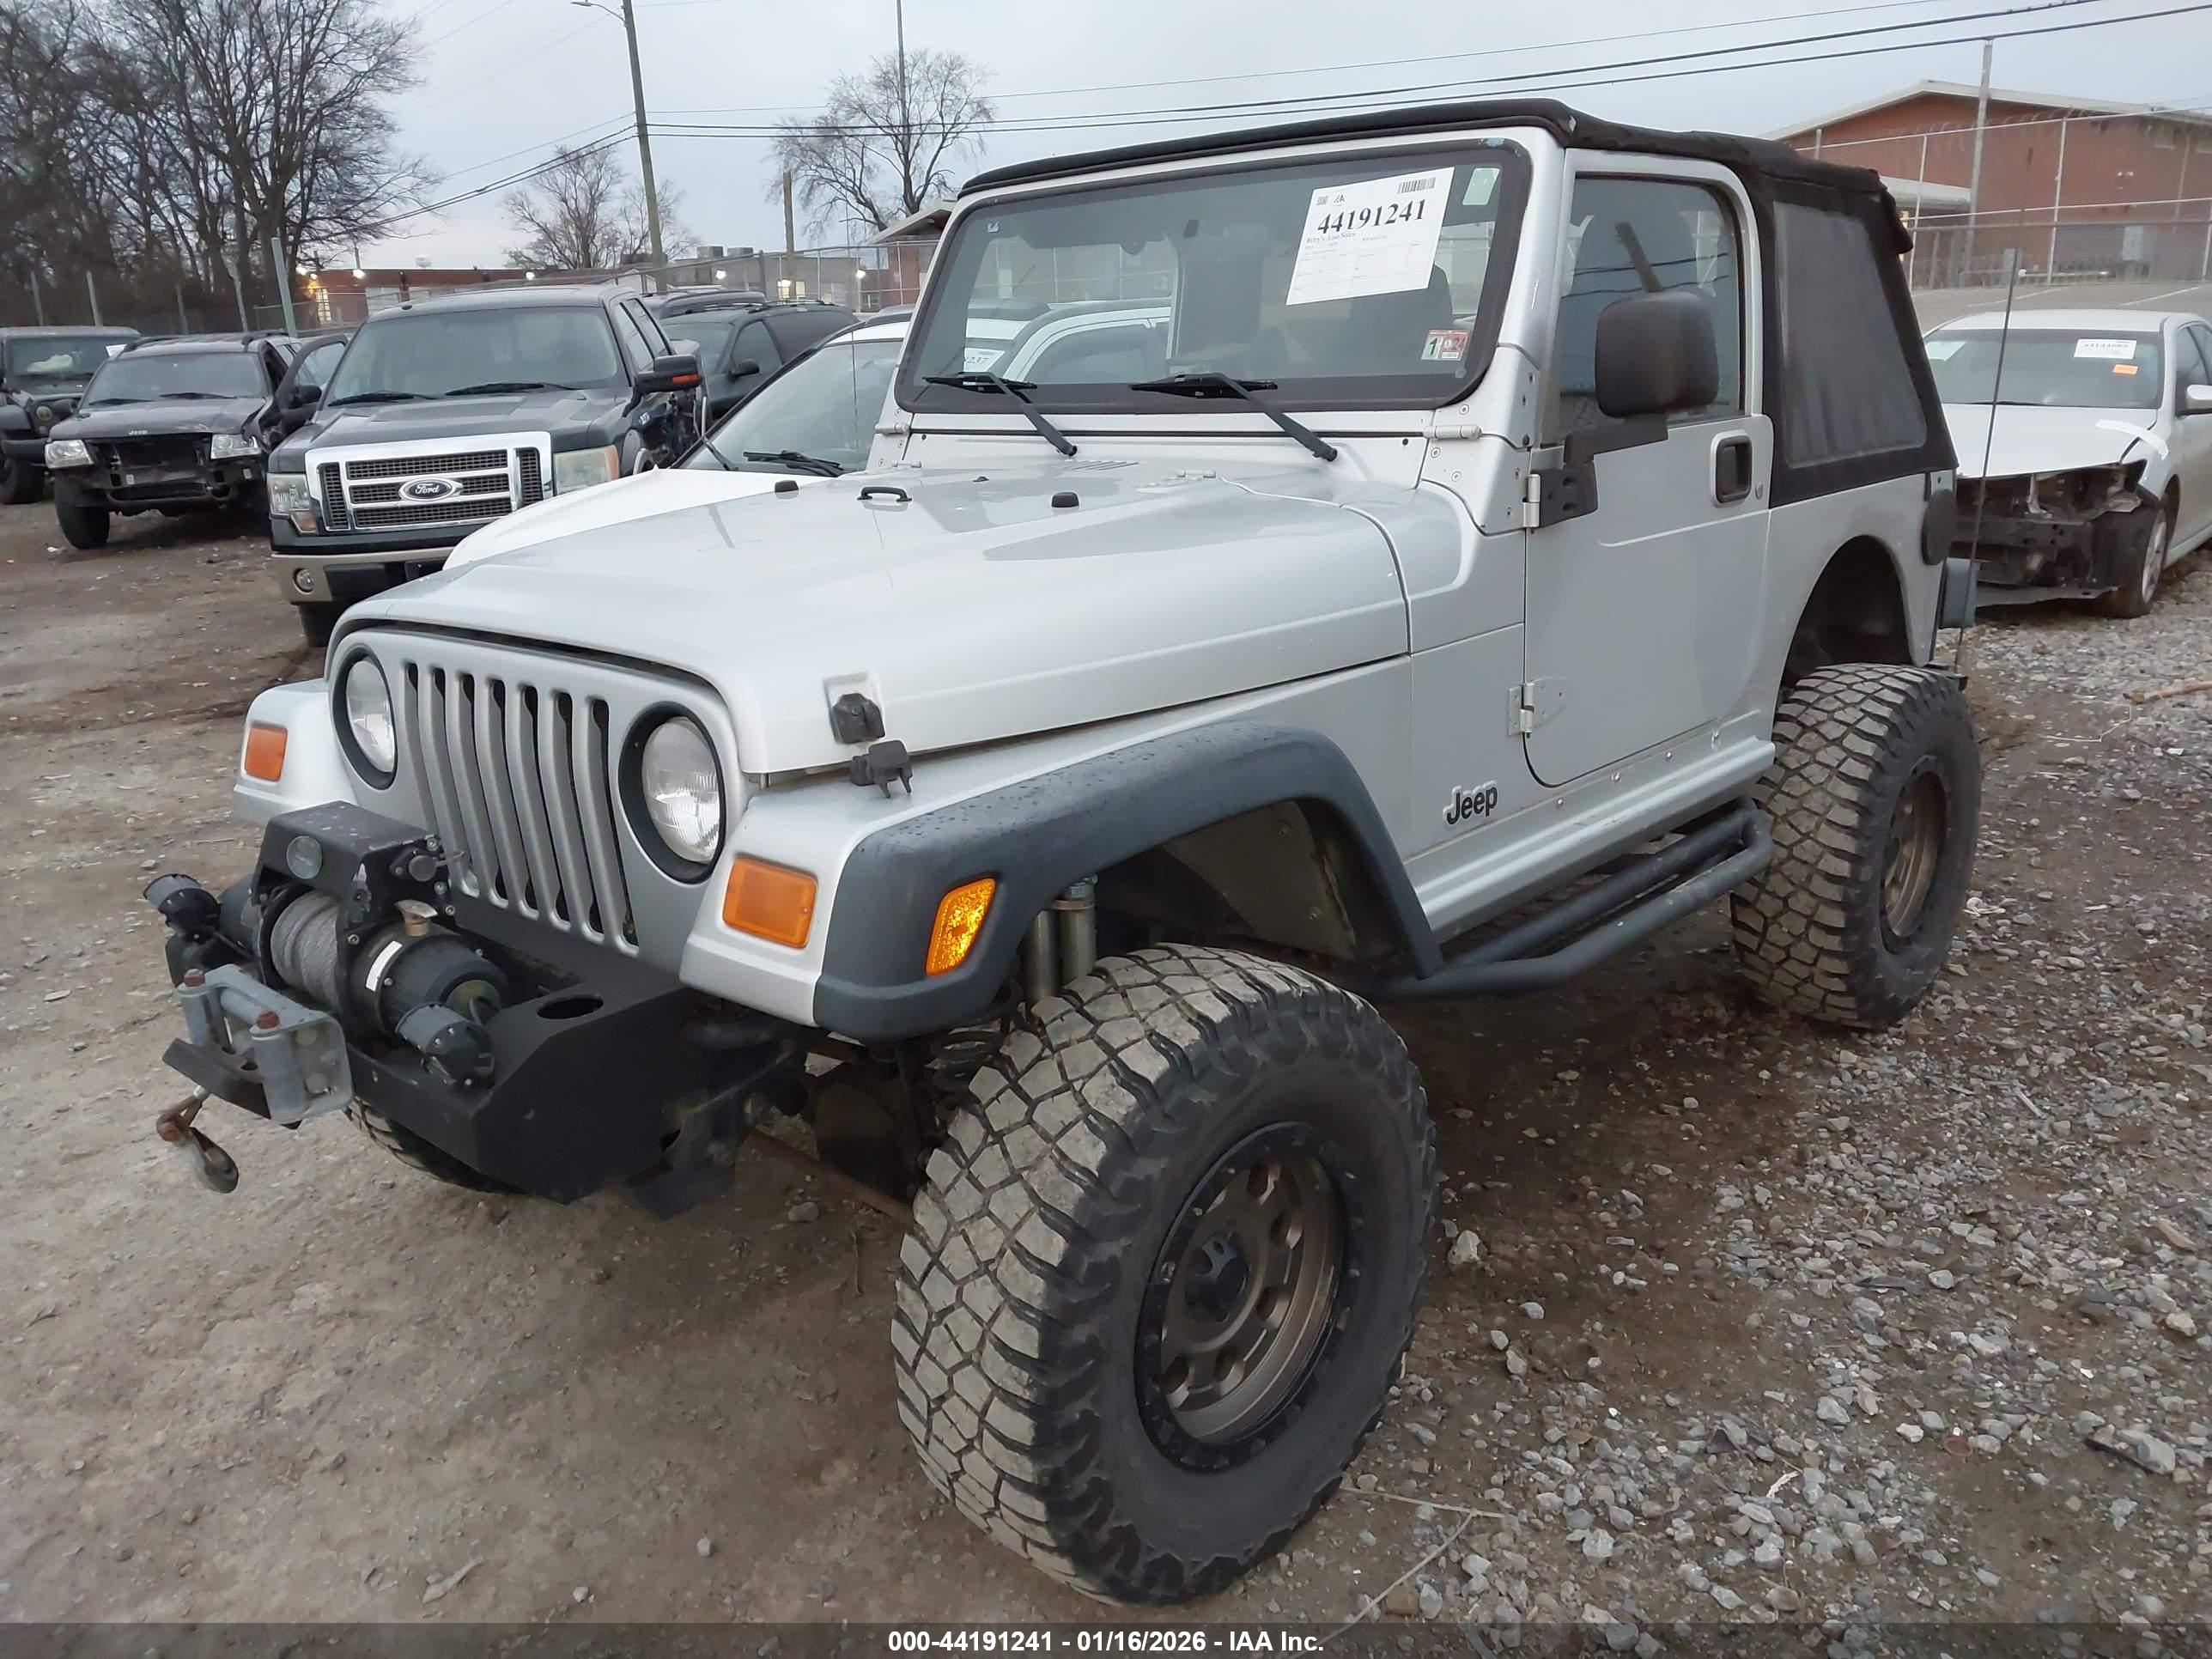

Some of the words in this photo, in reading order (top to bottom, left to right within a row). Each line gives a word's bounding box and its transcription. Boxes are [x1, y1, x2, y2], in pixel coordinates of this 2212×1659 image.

[1317, 198, 1426, 234] 44191241
[415, 483, 440, 495] Ford
[1445, 786, 1498, 825] Jeep
